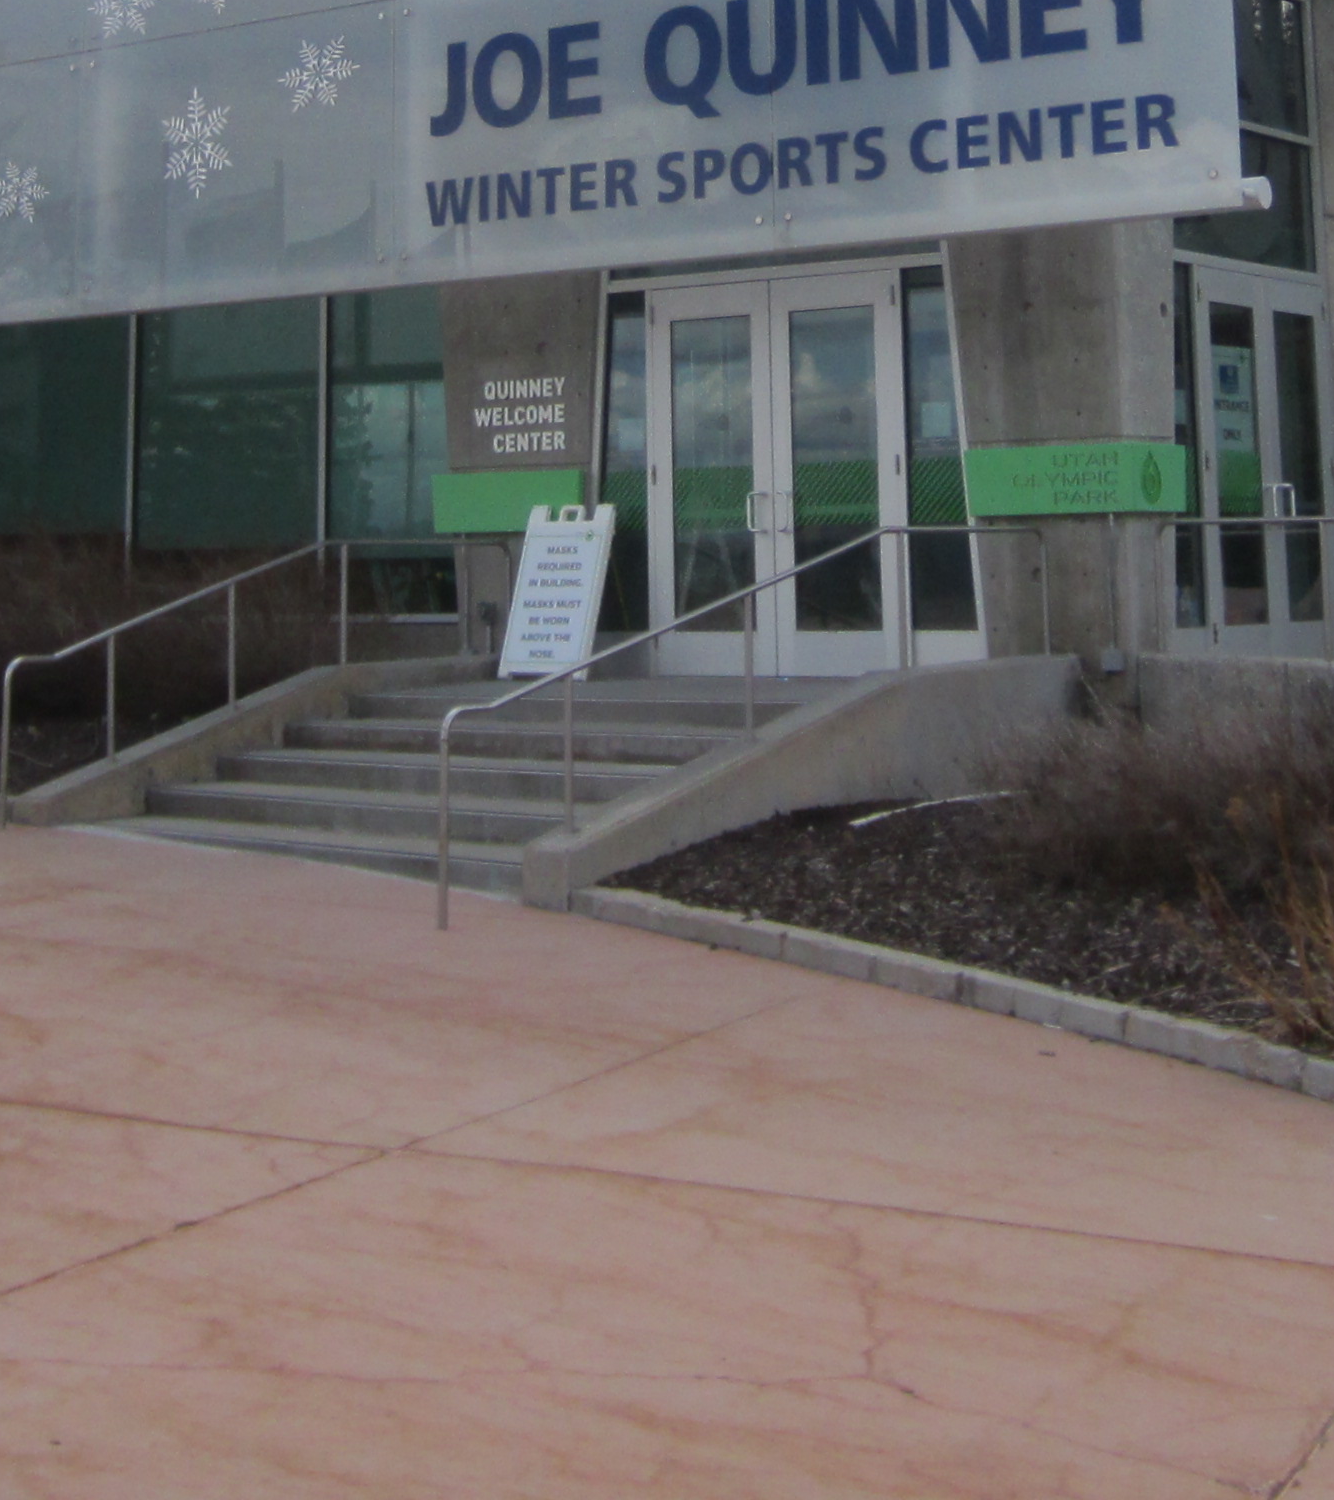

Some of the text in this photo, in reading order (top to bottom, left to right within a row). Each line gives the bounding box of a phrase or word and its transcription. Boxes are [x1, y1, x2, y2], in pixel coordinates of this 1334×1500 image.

[429, 21, 602, 138] JOE
[425, 93, 1179, 227] WINTER SPORTS CENTER
[484, 376, 566, 400] QUINNEY
[474, 403, 565, 428] WELCOME
[492, 430, 566, 454] CENTER
[1052, 451, 1120, 468] UTAH
[1012, 470, 1118, 489] OLYMPIC
[1053, 490, 1118, 506] PARK
[547, 546, 578, 554] MASKS
[537, 562, 582, 571] REQUIRED
[528, 579, 538, 587] IN
[556, 600, 581, 608] MUST
[528, 616, 570, 625] BE WORN
[521, 633, 571, 641] ABOVE THE
